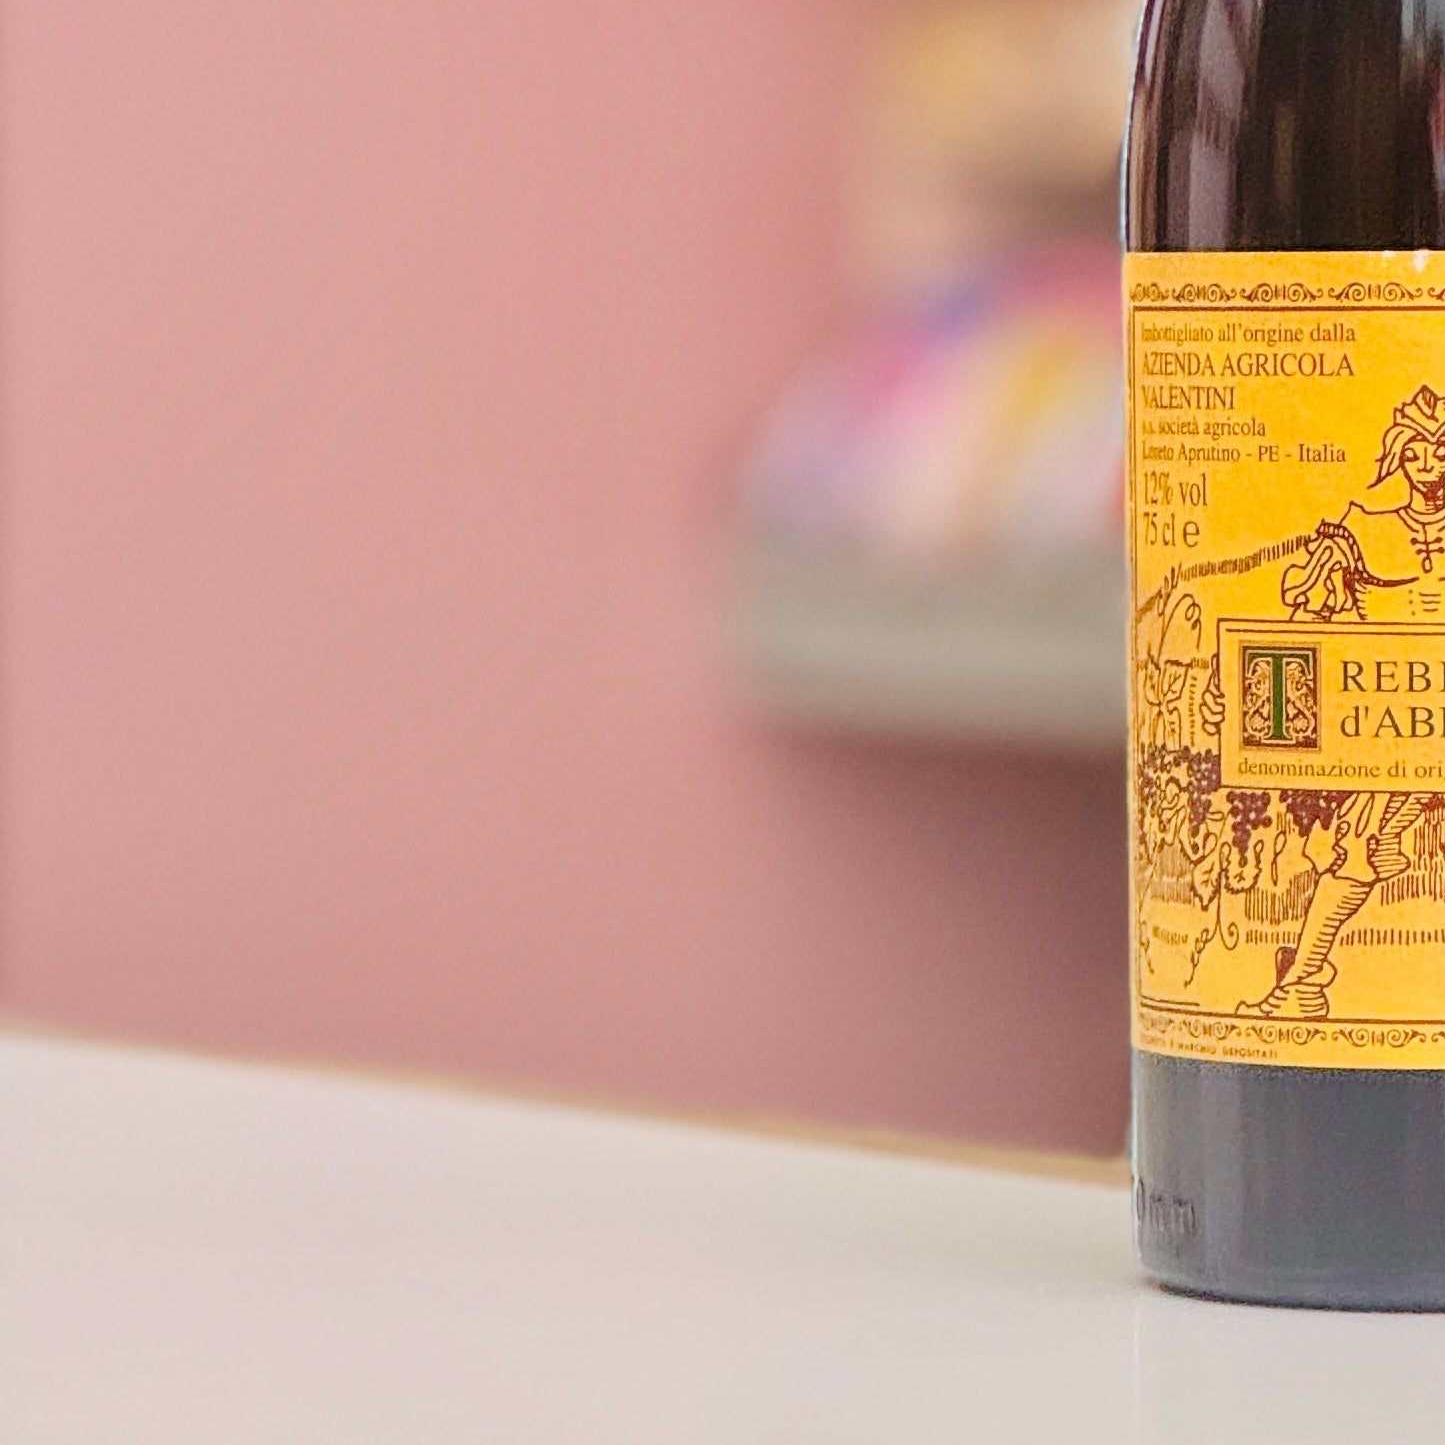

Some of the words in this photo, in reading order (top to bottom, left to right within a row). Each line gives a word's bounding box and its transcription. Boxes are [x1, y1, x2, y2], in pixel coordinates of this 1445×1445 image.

[1218, 322, 1304, 347] all'origine
[1310, 323, 1356, 342] dalla
[1141, 352, 1214, 377] AZIENDA
[1221, 352, 1355, 377] AGRICOLA
[1141, 386, 1235, 410] VALENTINI
[1157, 415, 1200, 436] società
[1203, 417, 1266, 440] agricola
[1177, 443, 1241, 466] Aprutino
[1257, 445, 1280, 462] PE
[1298, 443, 1347, 463] Italia
[1143, 470, 1174, 506] 12%
[1179, 472, 1208, 507] vol
[1143, 512, 1159, 547] 75
[1162, 513, 1176, 547] cl
[1238, 757, 1380, 778] denominazione
[1387, 760, 1408, 778] di
